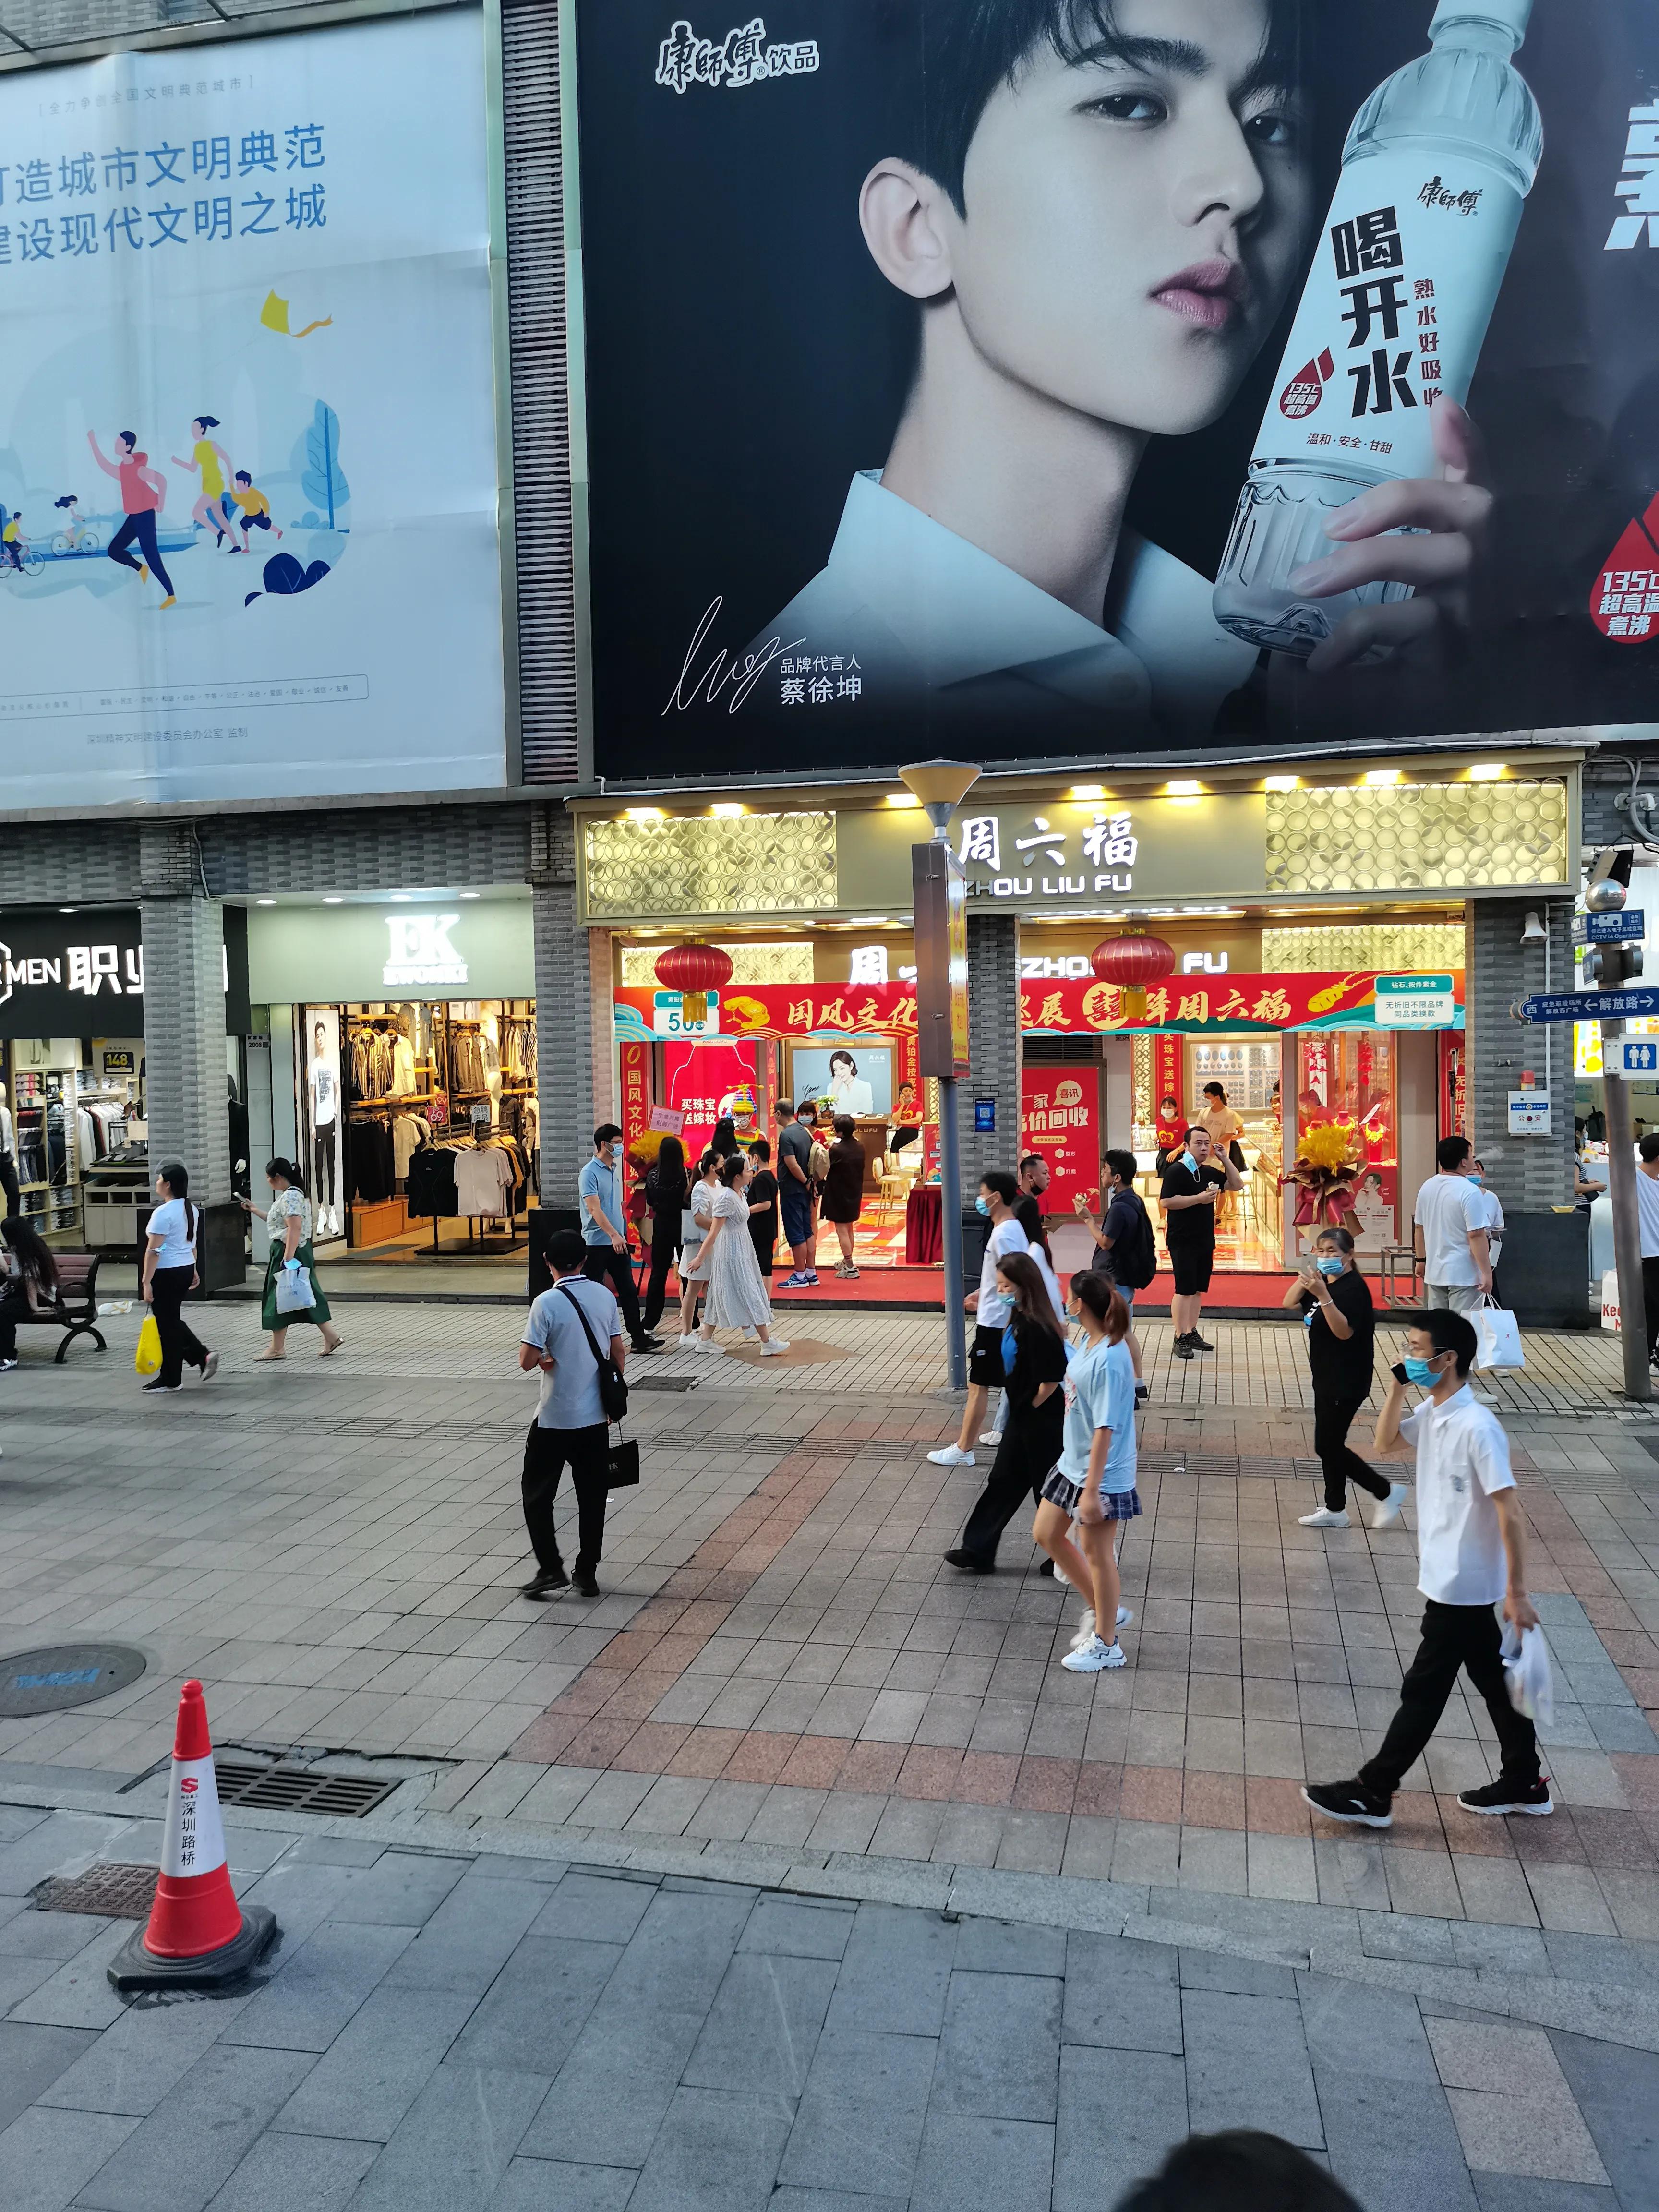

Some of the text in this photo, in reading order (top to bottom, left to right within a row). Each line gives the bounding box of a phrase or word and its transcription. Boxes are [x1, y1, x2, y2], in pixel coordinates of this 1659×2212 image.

[767, 41, 819, 76] 饮品
[1331, 206, 1418, 418] 喝开水
[1283, 394, 1318, 405] 超高温
[1599, 593, 1659, 615] 超高温
[1606, 614, 1651, 636] 煮沸
[780, 653, 862, 674] 品牌代言人
[780, 674, 862, 705] 蔡徐坤
[958, 811, 1138, 872] 周六福
[965, 874, 1132, 897] ZHOU LIU FU
[1021, 952, 1228, 978] ZHO FU
[788, 997, 918, 1031] 国风文化
[1385, 1000, 1444, 1010] 无折旧不限品牌
[1394, 1010, 1436, 1018] 同品类换款
[1526, 1004, 1537, 1014] 西
[1599, 995, 1638, 1010] 解放路
[107, 1054, 128, 1066] 148
[1164, 1034, 1175, 1097] 买珠宝送嫁
[627, 1070, 643, 1138] 国风文化
[681, 1097, 717, 1111] 买珠宝
[1059, 1088, 1079, 1099] 喜讯
[430, 1110, 444, 1122] 69
[685, 1111, 717, 1125] 送嫁妆
[181, 1801, 196, 1866] 深圳路桥
